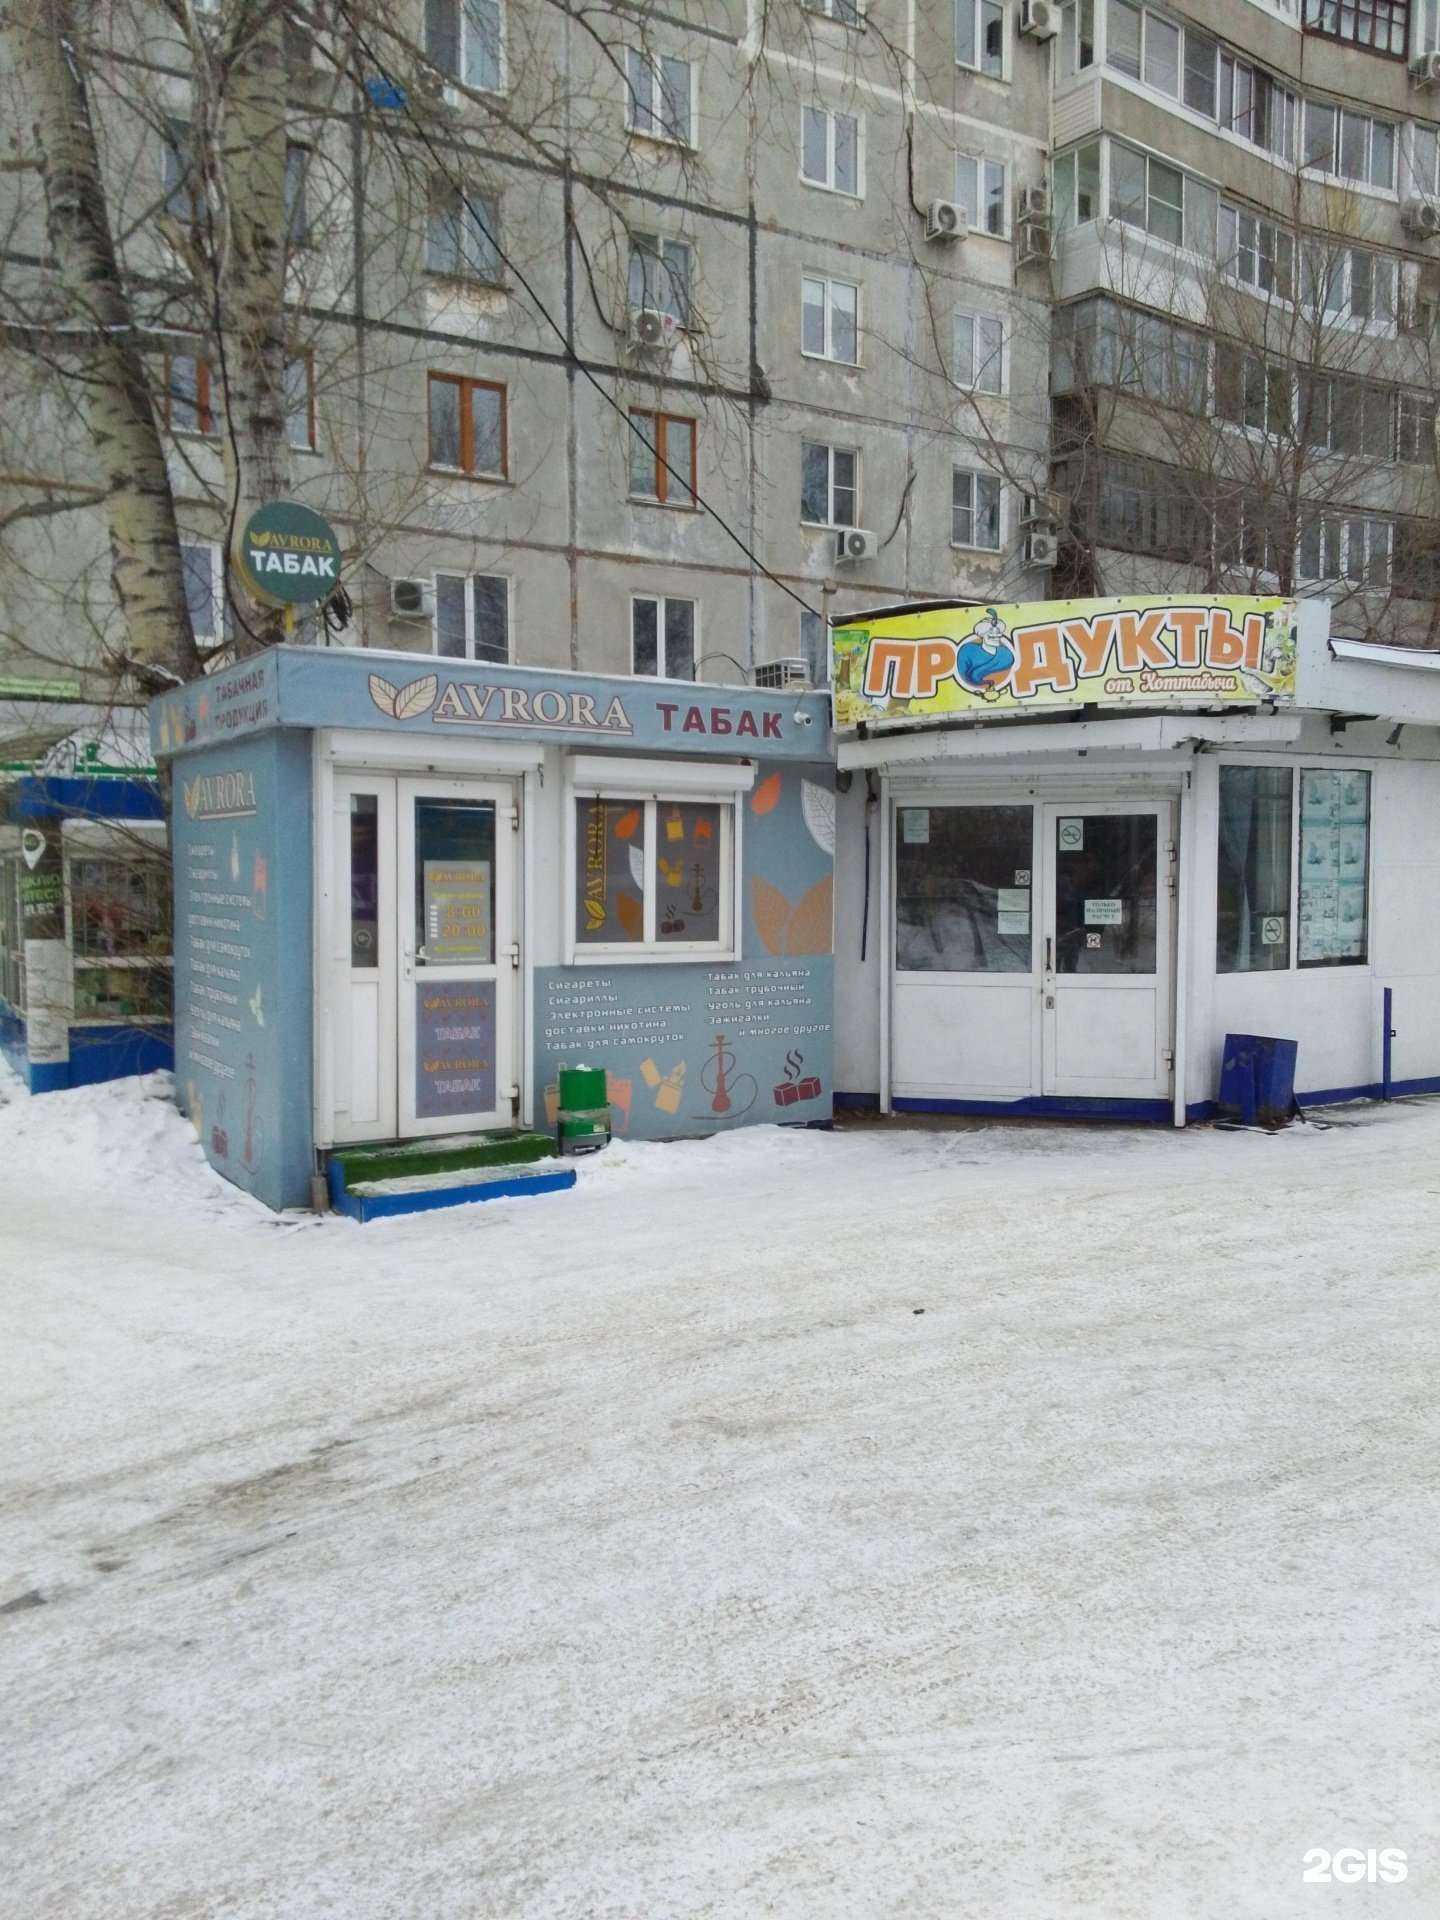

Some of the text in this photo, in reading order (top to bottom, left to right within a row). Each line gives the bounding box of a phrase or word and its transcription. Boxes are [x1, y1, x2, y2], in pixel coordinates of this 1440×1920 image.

[270, 532, 333, 552] AVRORA
[250, 550, 336, 577] ТАБАК
[865, 606, 1268, 699] ПРОДУКТЫ
[215, 669, 265, 703] ТАБАЧНАЯ
[1105, 671, 1238, 694] от Хоттабыча
[214, 699, 268, 730] ПРОДУКЦИЯ
[433, 682, 633, 730] AVRORA
[655, 702, 783, 740] ТАБАК
[200, 770, 257, 811] AVRORA
[586, 803, 604, 900] AVRORA
[548, 979, 612, 990] Сигареты
[708, 969, 811, 981] Табак для кальяна
[708, 984, 804, 995] Табак трубочный
[548, 994, 618, 1006] Сигариллы
[745, 999, 764, 1009] для
[768, 997, 812, 1006] кальяна
[550, 1004, 691, 1020] Электронные системы
[709, 1014, 770, 1025] Зажигалки
[545, 1020, 667, 1038] доставки никотина
[739, 1023, 832, 1036] и многое другое
[545, 1033, 684, 1050] Табак для самокруток
